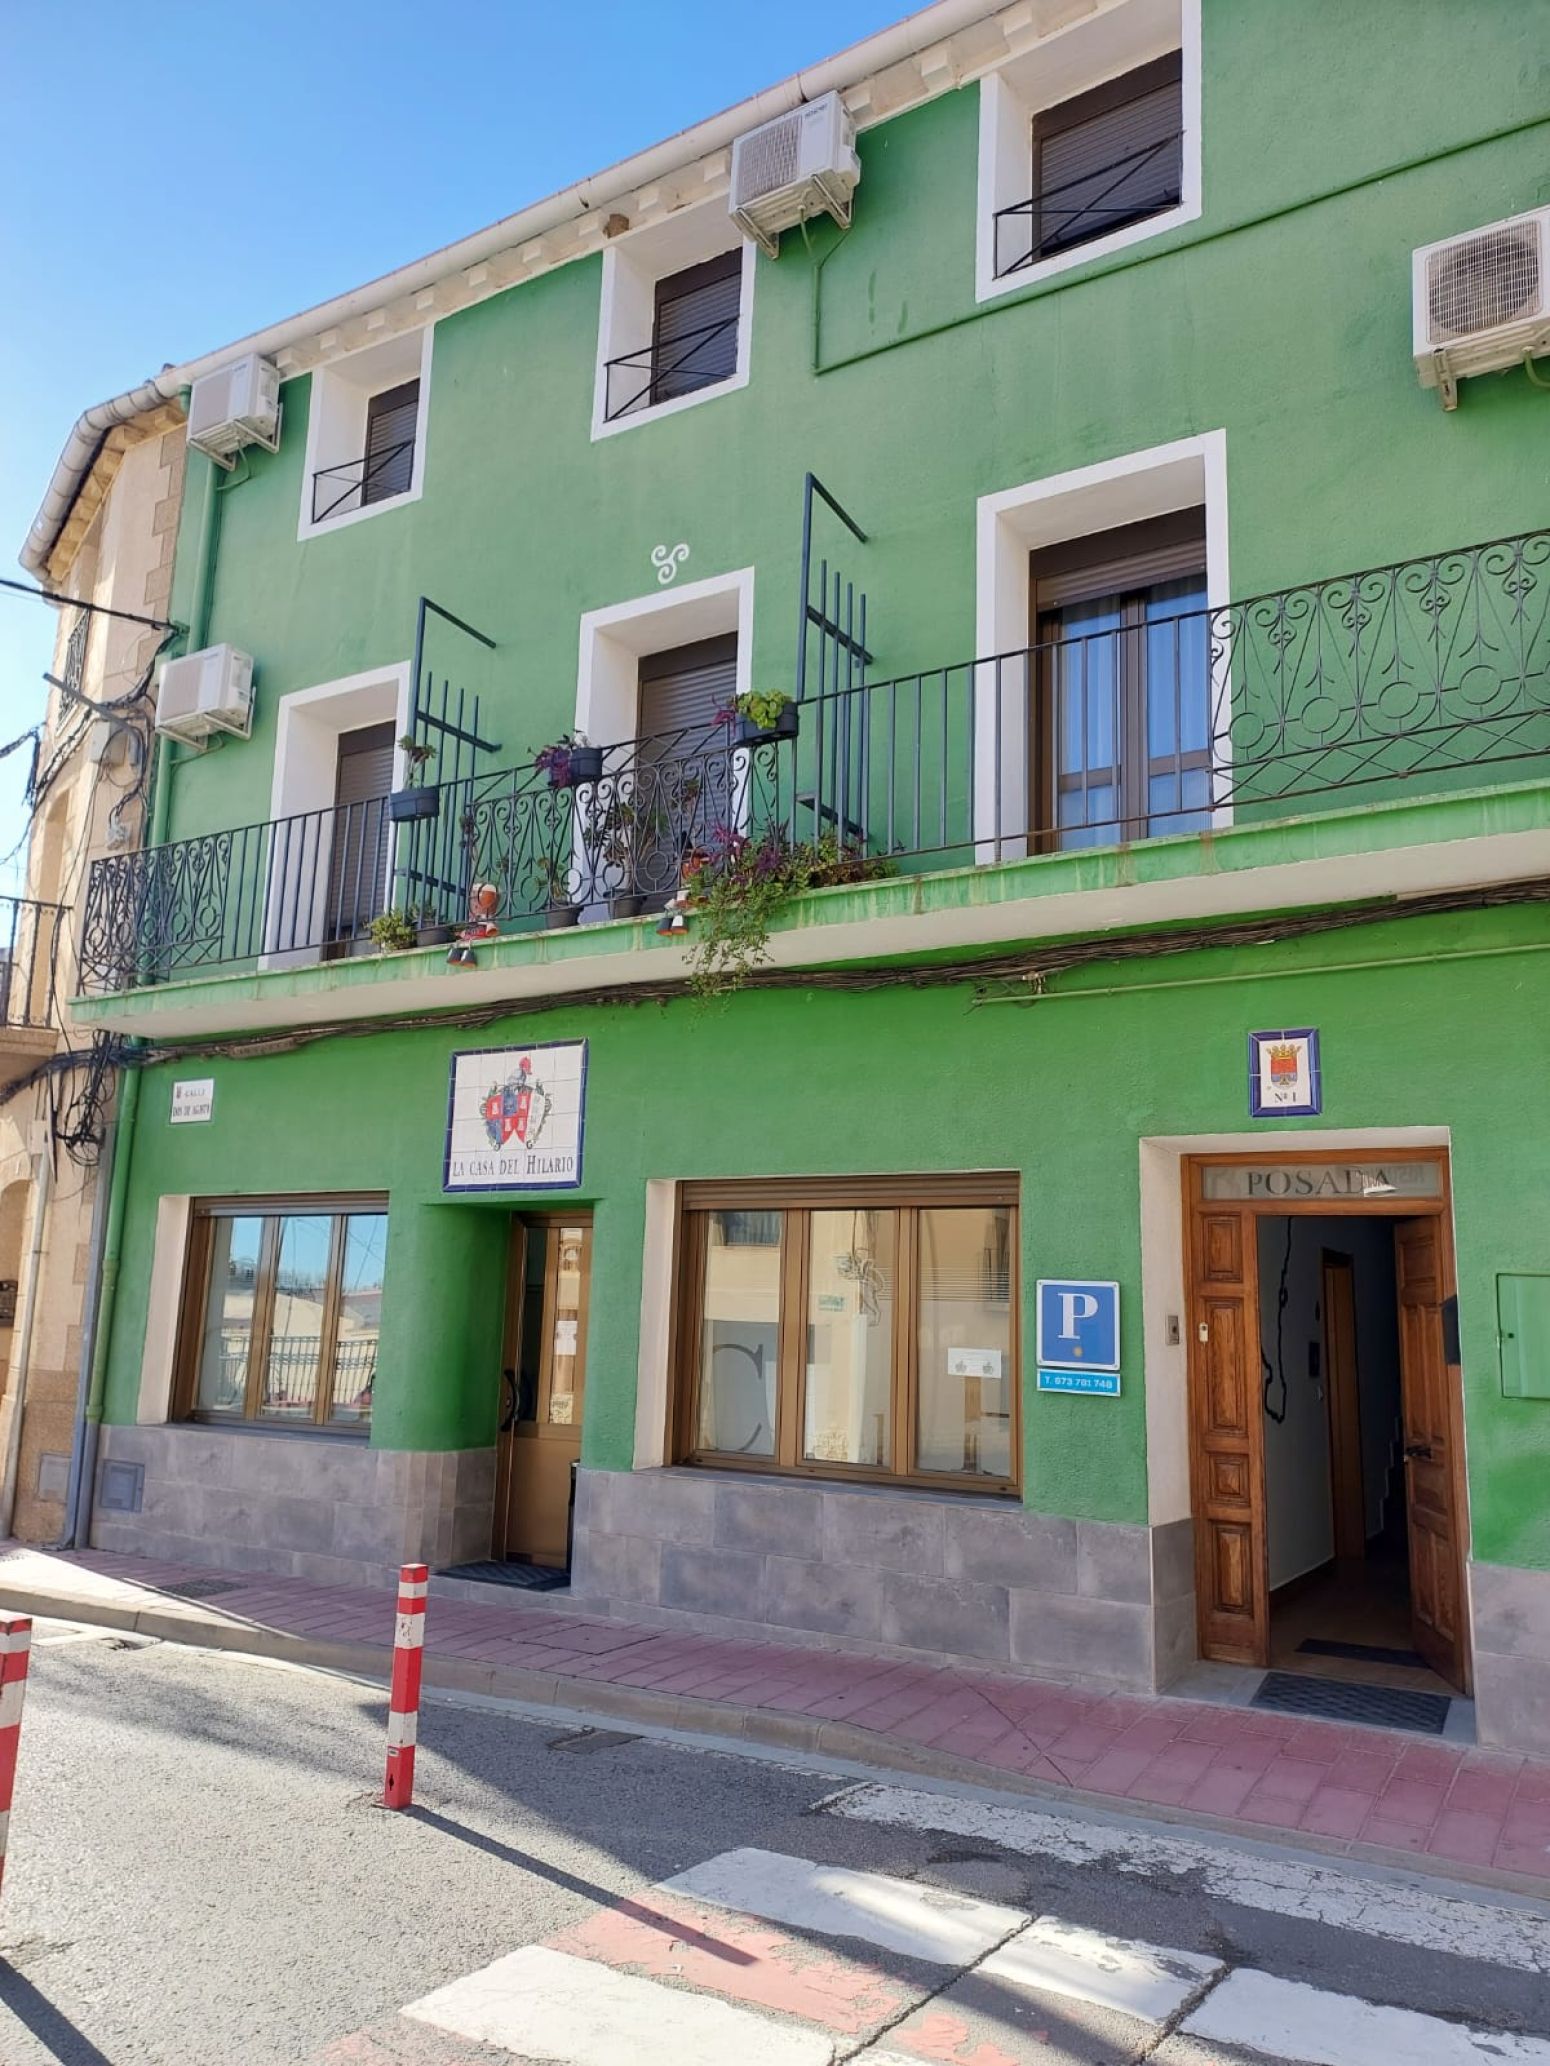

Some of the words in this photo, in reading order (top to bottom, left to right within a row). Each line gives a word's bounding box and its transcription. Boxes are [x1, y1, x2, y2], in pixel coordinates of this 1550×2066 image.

[452, 1160, 465, 1177] LA
[469, 1159, 495, 1176] CASA
[499, 1158, 520, 1175] DEL
[526, 1155, 573, 1175] HILARIO
[1247, 1168, 1397, 1196] POSADA
[1056, 1292, 1099, 1340] P
